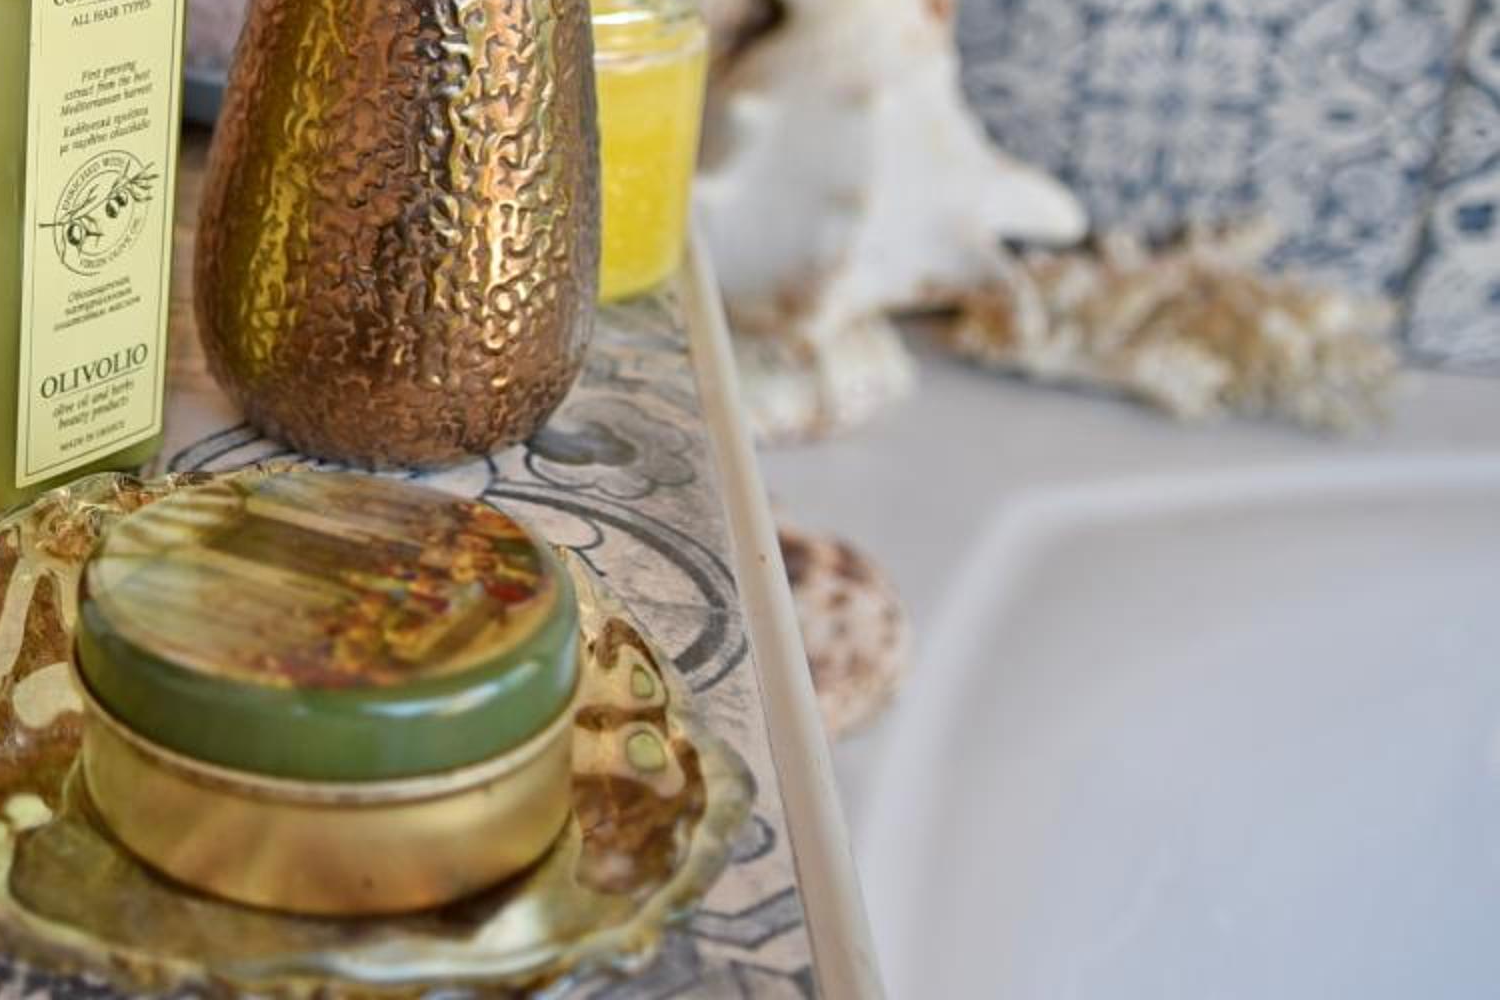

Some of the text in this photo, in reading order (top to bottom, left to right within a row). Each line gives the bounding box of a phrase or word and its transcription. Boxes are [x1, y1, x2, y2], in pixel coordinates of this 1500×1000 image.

[71, 12, 90, 27] ALL
[94, 6, 118, 22] HAIR
[40, 343, 148, 399] OLIVOLIO
[53, 402, 74, 417] olive
[77, 395, 90, 409] oil
[92, 388, 108, 402] and
[58, 395, 129, 429] beauty products
